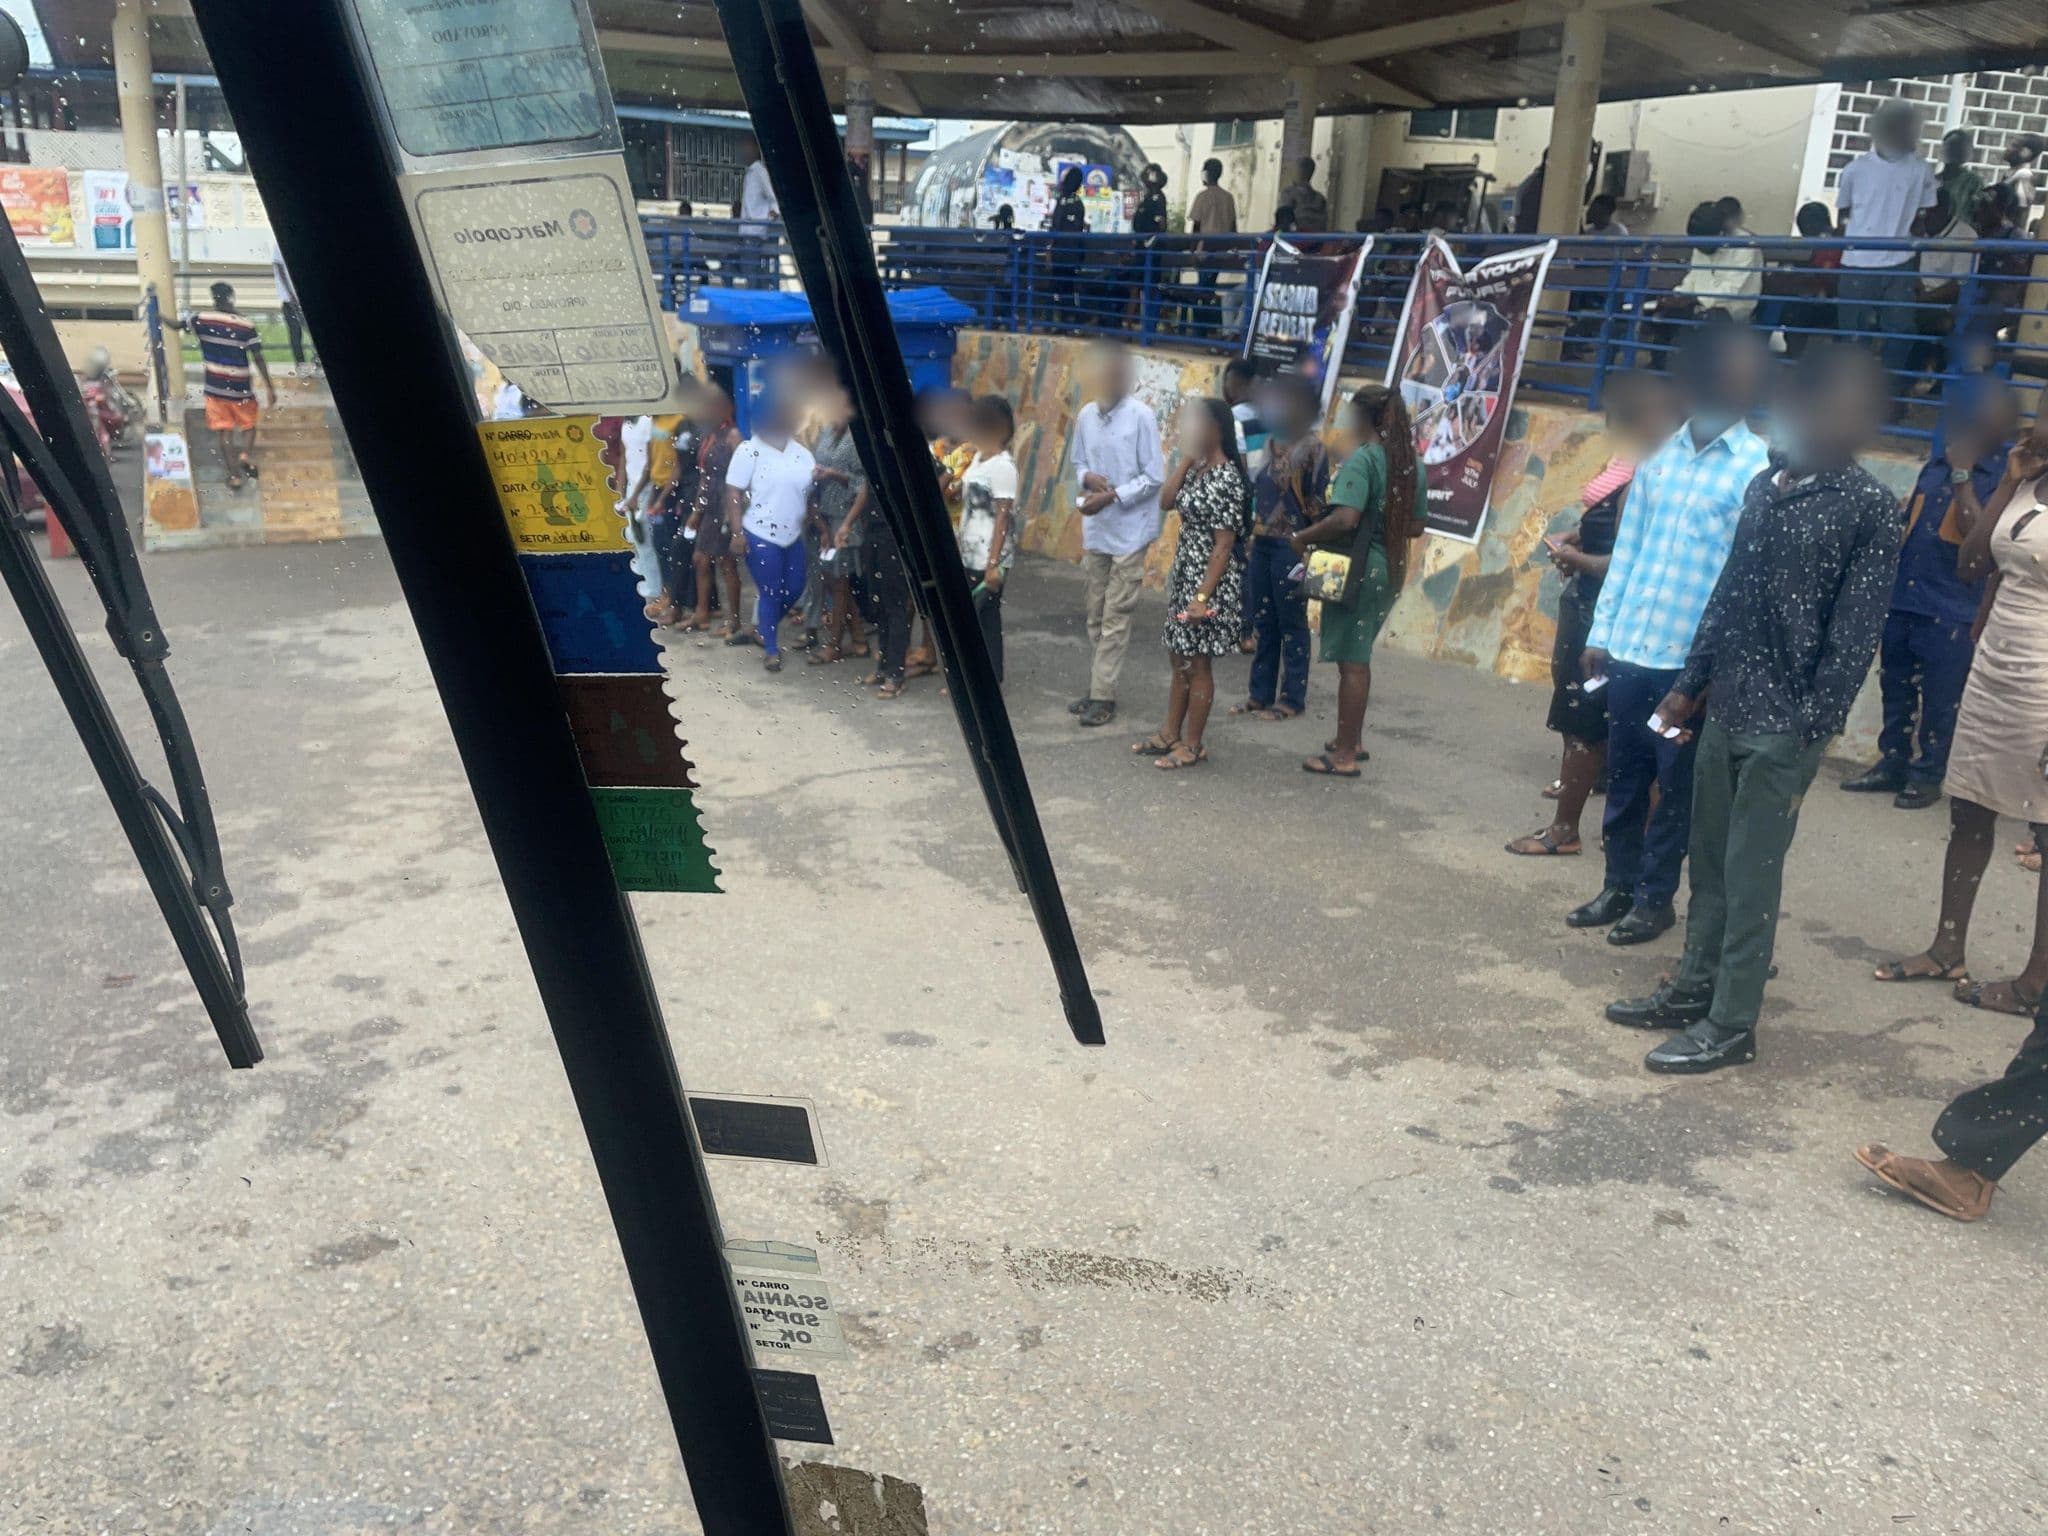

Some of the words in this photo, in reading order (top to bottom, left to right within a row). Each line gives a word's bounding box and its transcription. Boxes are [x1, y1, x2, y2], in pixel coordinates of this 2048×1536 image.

[1480, 256, 1536, 281] YOUR
[1264, 281, 1319, 315] SECOND
[502, 484, 529, 493] DATA
[520, 534, 551, 543] SETOR
[751, 1280, 790, 1291] CARRO
[745, 1306, 774, 1316] DATA
[755, 1339, 792, 1350] SETOR
